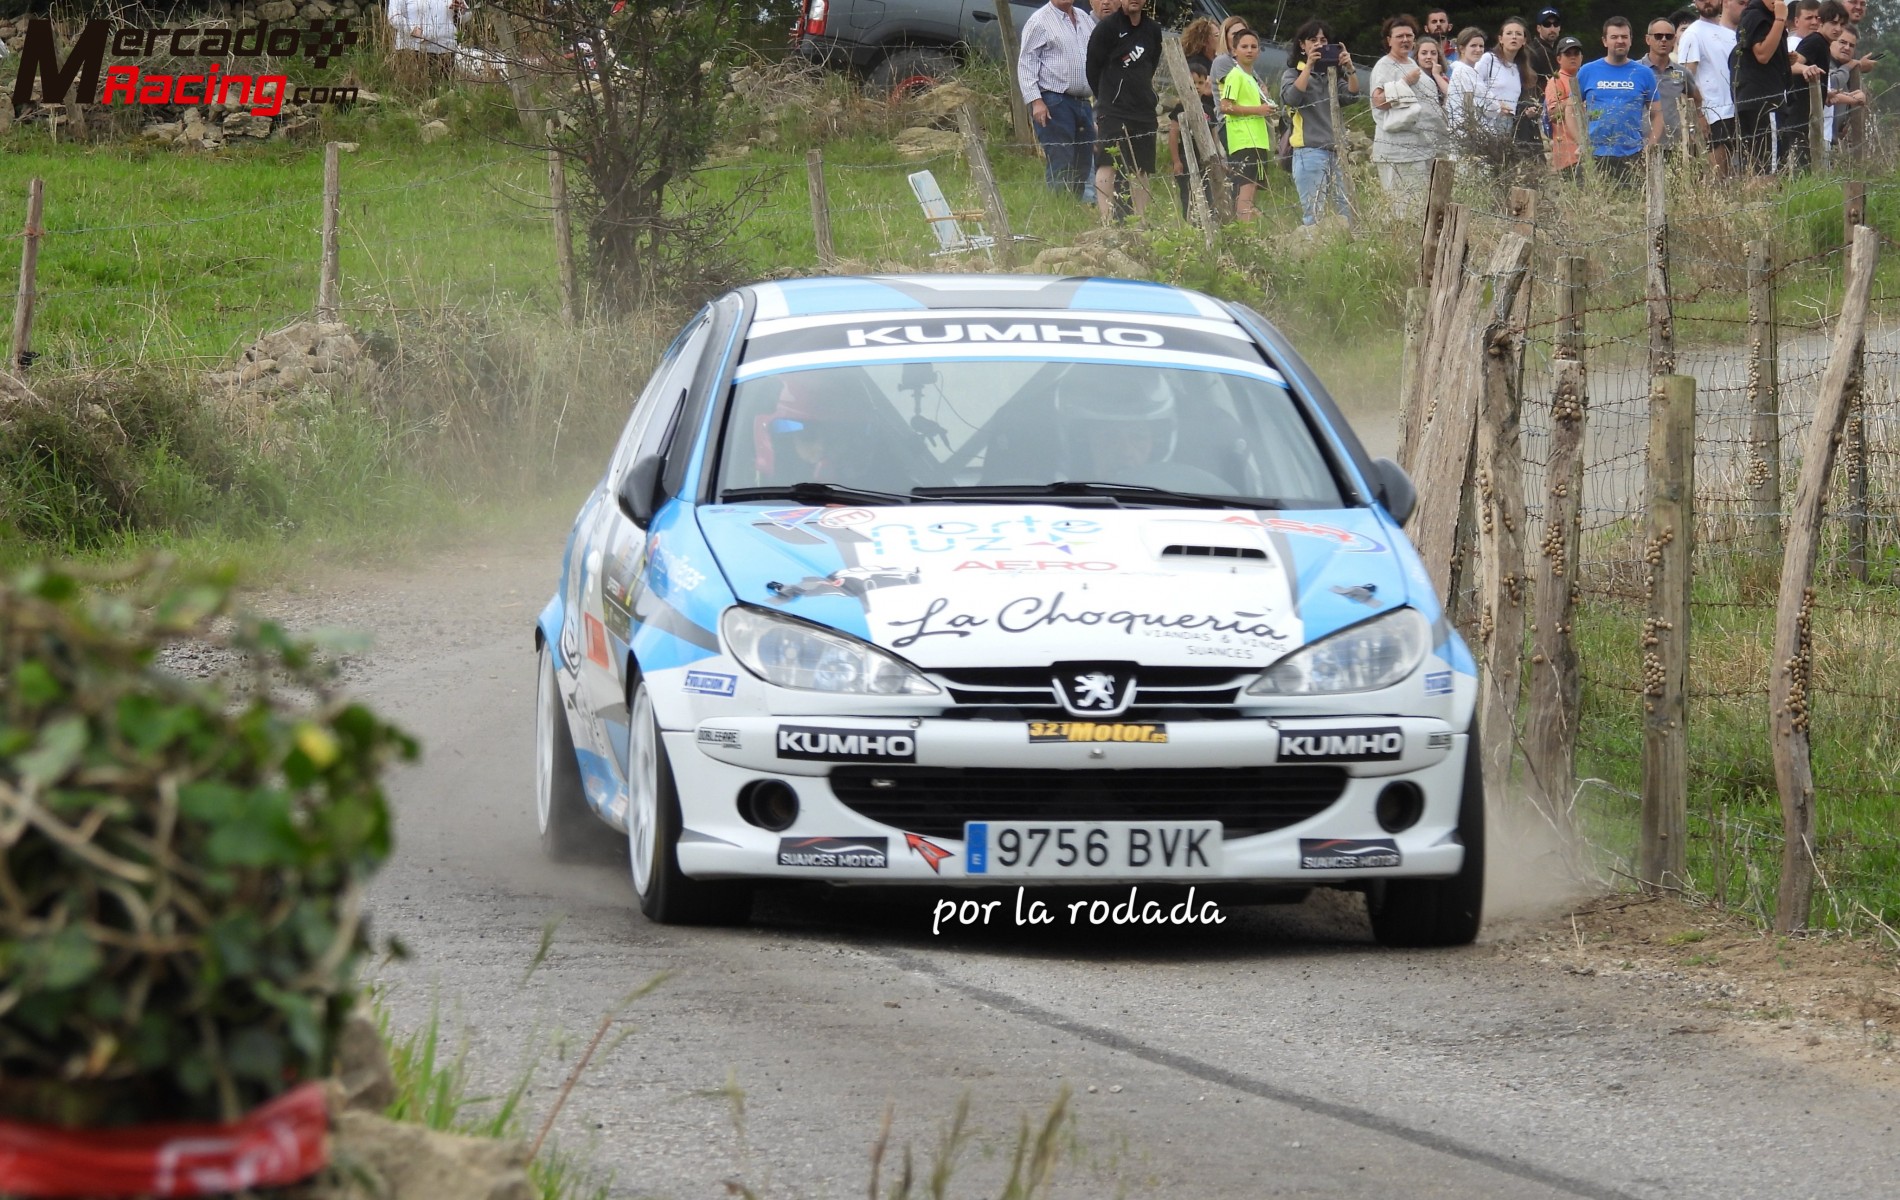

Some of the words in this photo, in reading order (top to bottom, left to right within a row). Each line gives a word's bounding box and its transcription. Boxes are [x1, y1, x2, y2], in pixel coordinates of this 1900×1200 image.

[846, 323, 1166, 349] KUMHO
[952, 559, 1120, 572] AERO
[888, 598, 988, 648] La
[1186, 645, 1254, 660] SUANCES
[778, 730, 915, 757] KUMHO
[1280, 732, 1403, 757] KUMHO
[780, 852, 837, 866] SUANCES
[838, 853, 886, 868] MOTOR
[996, 828, 1110, 868] 9756
[1128, 828, 1212, 868] BVK
